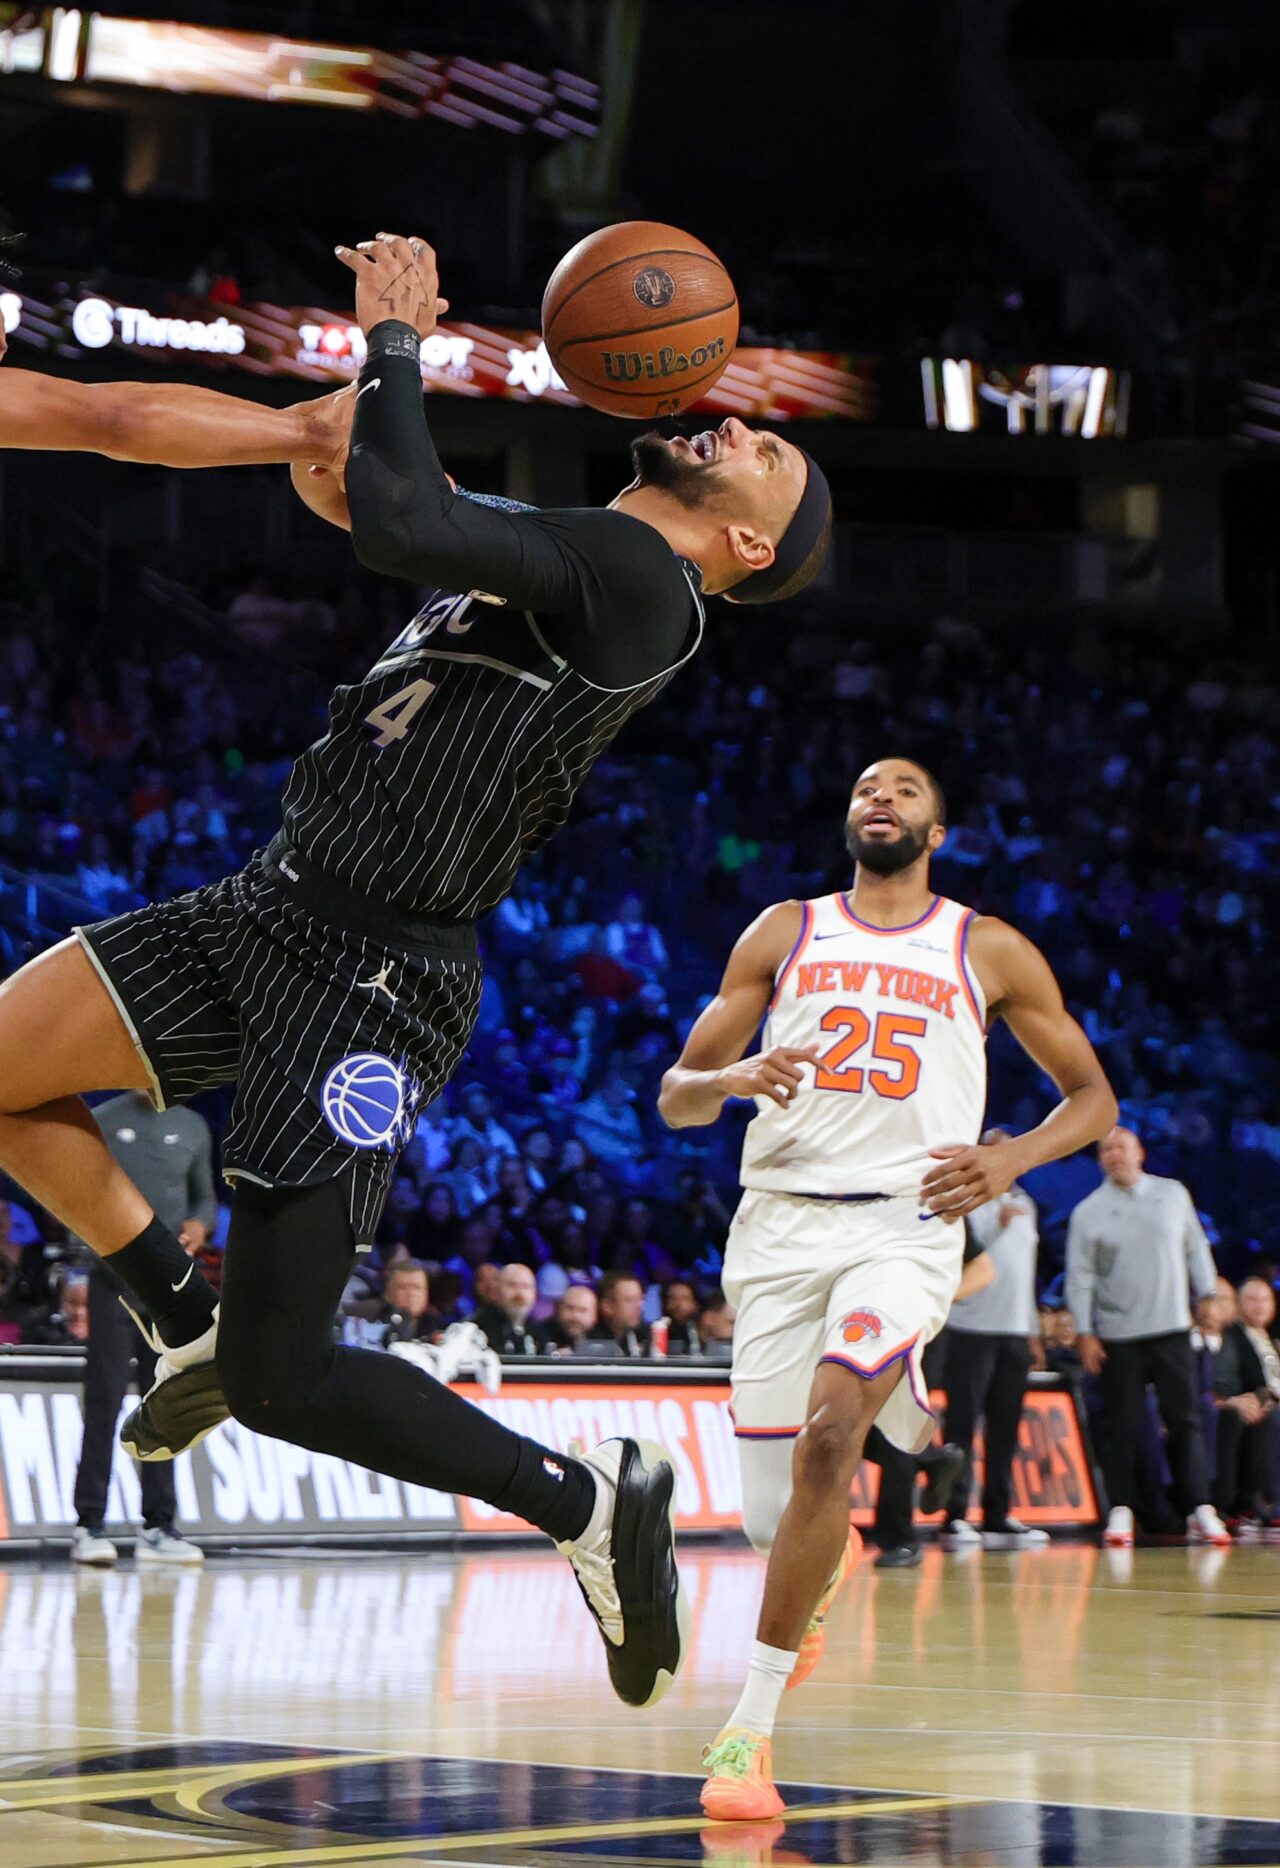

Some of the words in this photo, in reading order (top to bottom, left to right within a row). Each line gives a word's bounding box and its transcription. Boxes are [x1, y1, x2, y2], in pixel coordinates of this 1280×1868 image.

[116, 307, 246, 354] Threads
[601, 336, 725, 382] Wilson
[362, 677, 437, 750] 4
[796, 961, 872, 998] NEW
[874, 962, 960, 1020] YORK
[814, 1005, 928, 1101] 25
